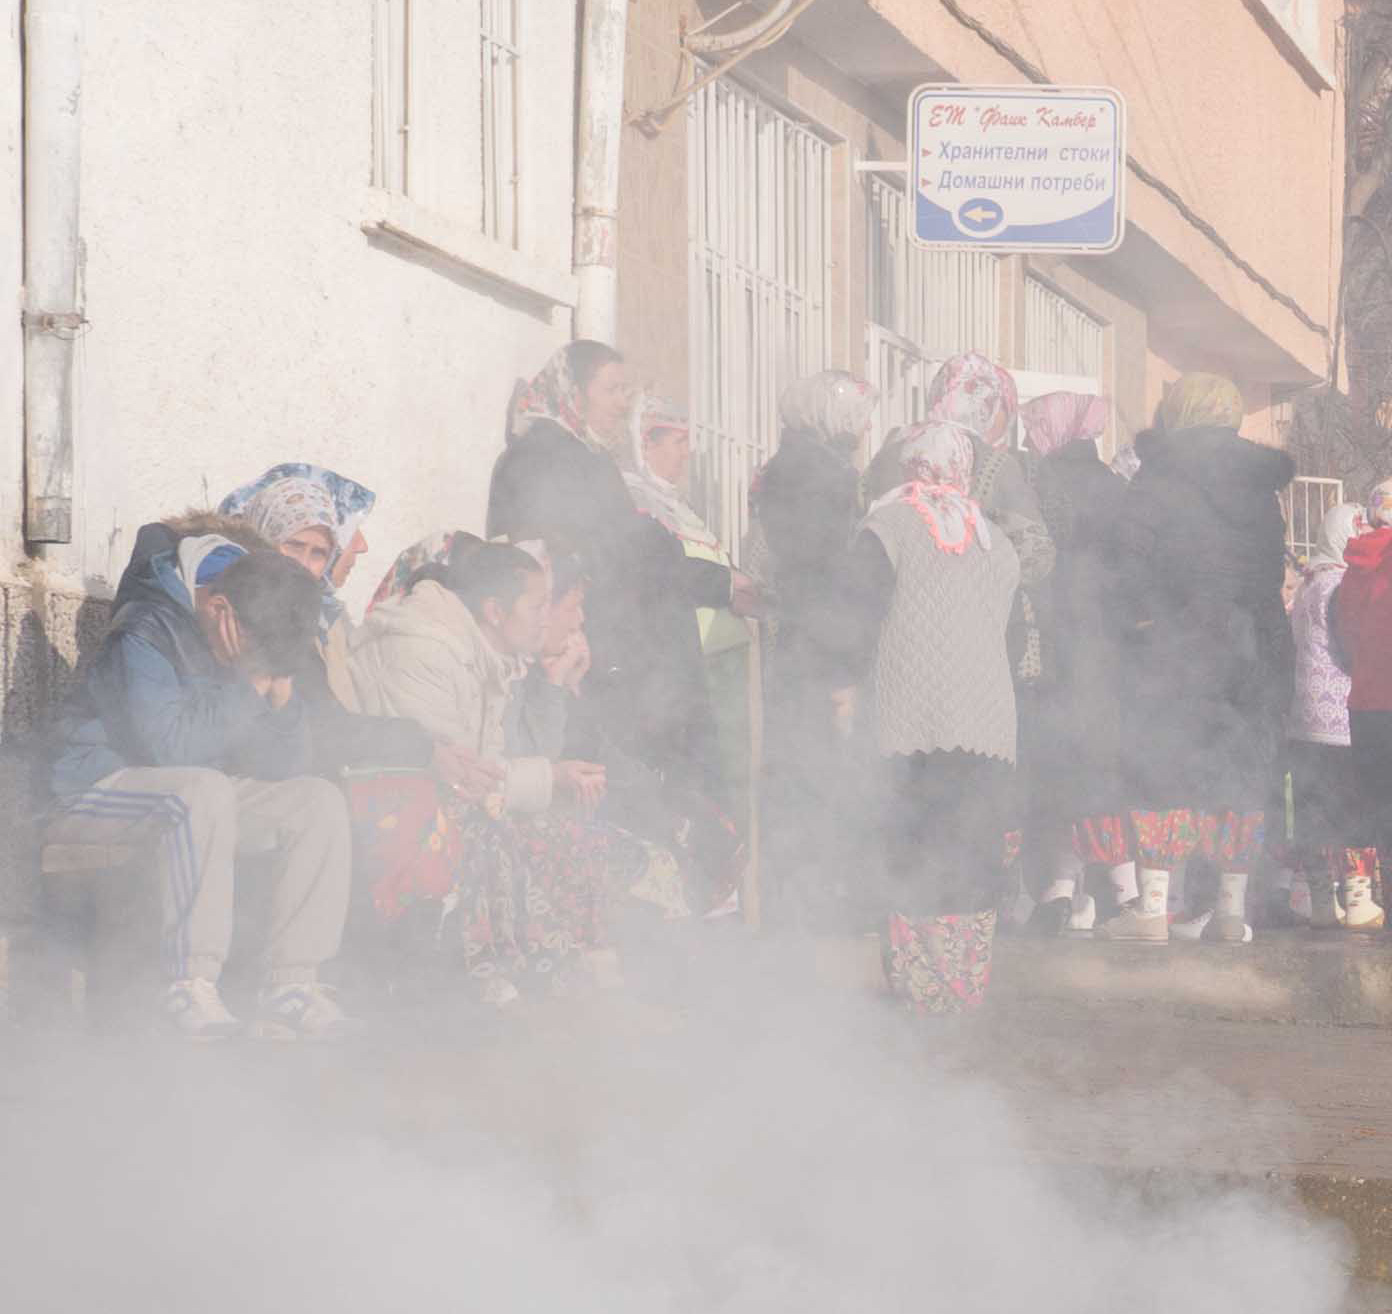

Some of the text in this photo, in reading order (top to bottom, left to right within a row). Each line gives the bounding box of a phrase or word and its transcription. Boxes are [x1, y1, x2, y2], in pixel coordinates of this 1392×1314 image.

[938, 140, 1111, 162] Хранителни стоки
[937, 170, 1106, 194] Домашни потреби
